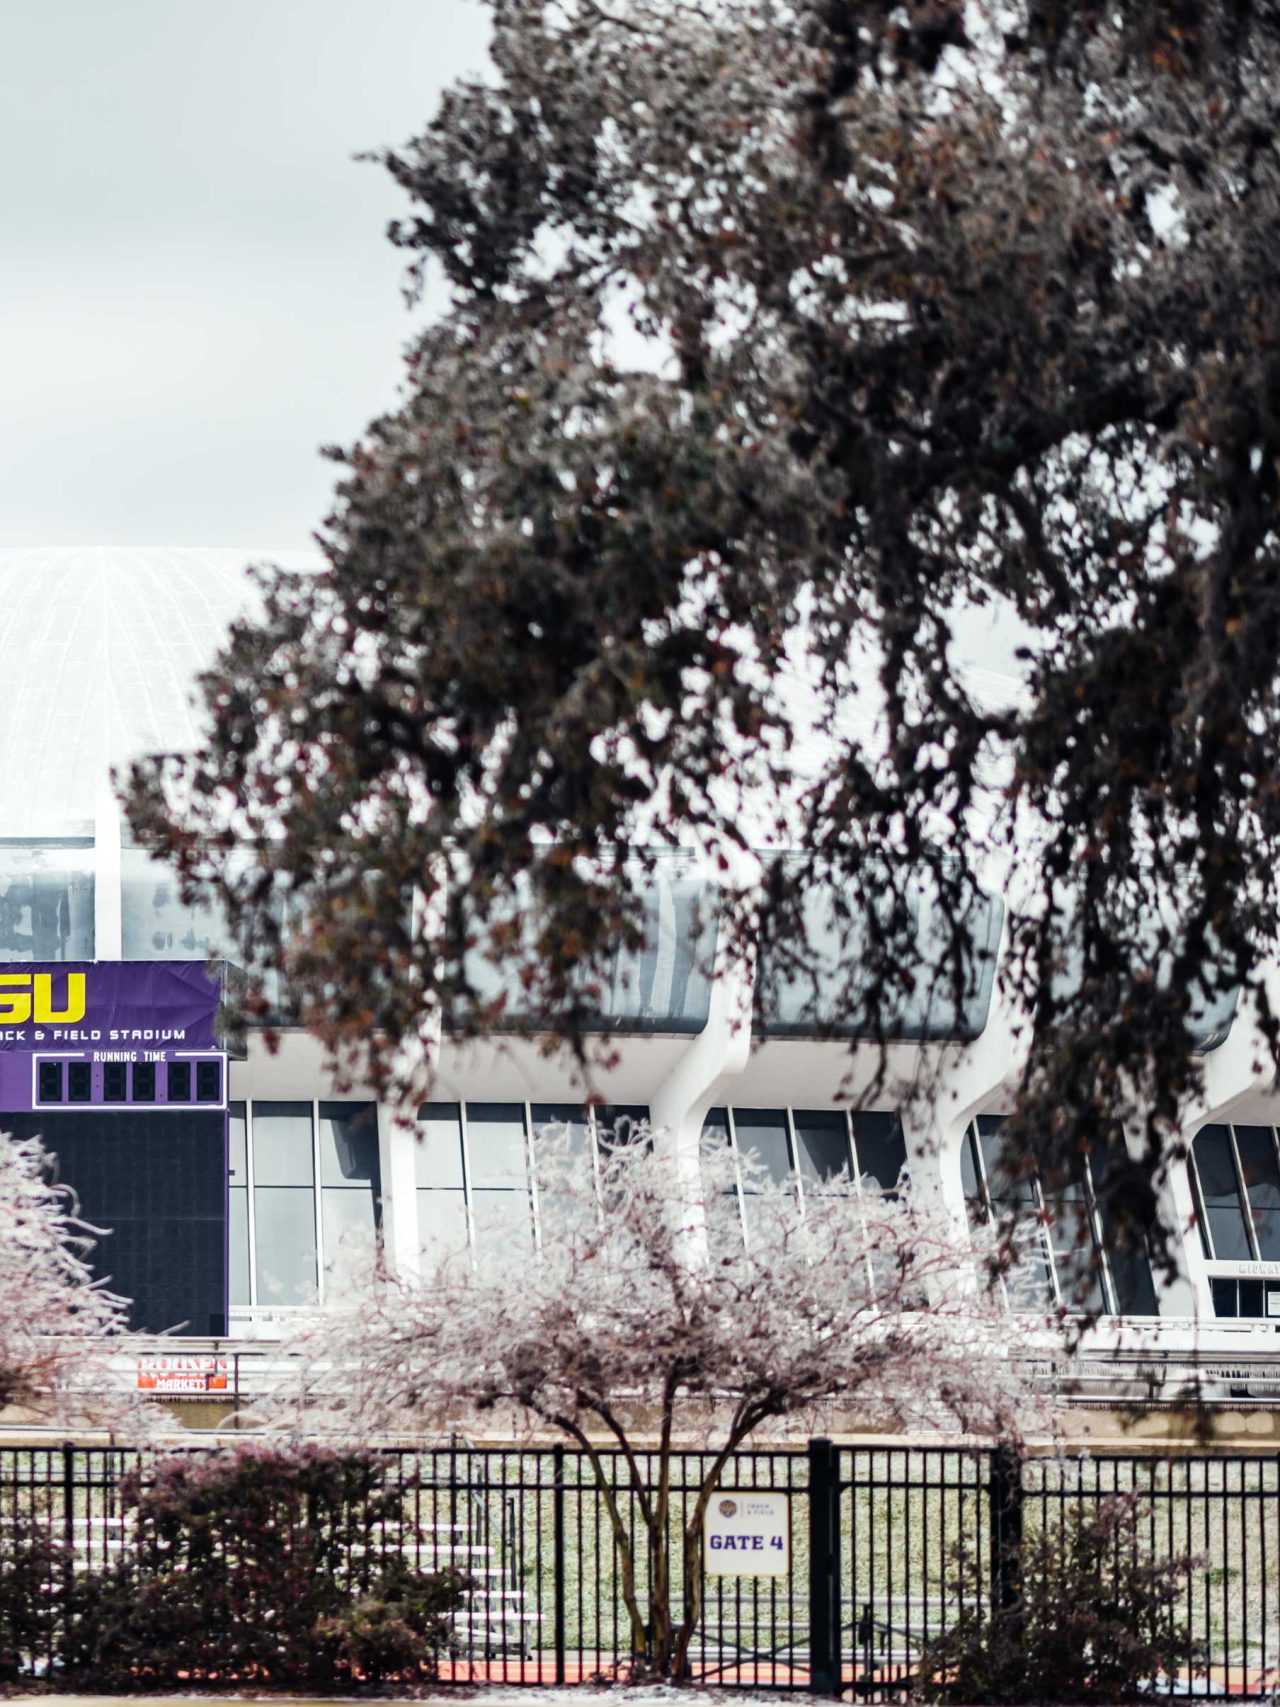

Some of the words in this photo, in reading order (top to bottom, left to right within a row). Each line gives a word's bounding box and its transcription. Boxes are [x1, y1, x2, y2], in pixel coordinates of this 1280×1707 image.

[34, 1031, 45, 1041] &
[53, 1030, 101, 1040] FIELD
[109, 1030, 186, 1040] STADIUM
[93, 1051, 137, 1062] RUNNING
[143, 1051, 166, 1062] TIME
[710, 1535, 764, 1550] GATE
[770, 1535, 784, 1550] 4
